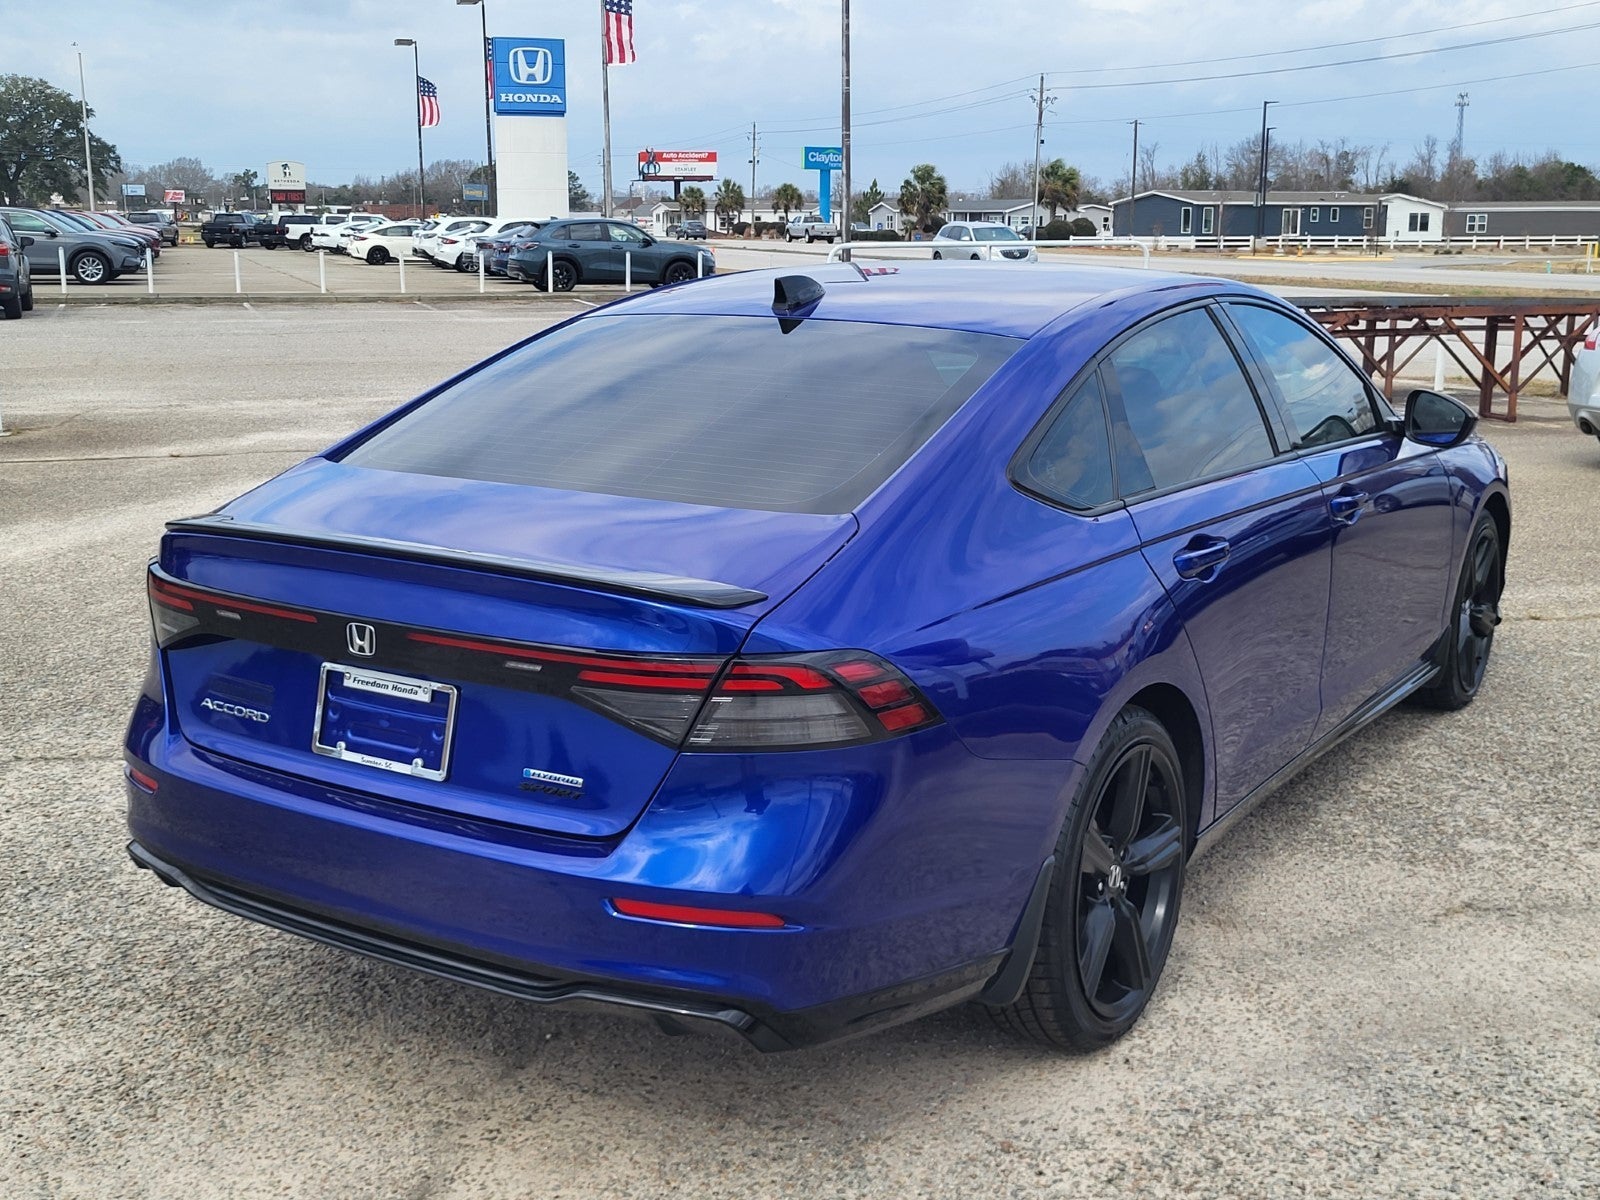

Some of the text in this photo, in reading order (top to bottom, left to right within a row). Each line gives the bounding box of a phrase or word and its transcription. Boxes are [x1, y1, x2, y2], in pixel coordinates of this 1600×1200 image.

[500, 93, 563, 104] HONDA
[352, 677, 418, 696] Freedom Honda
[200, 698, 270, 723] ACCORD
[531, 771, 580, 785] HYBRID
[520, 782, 585, 800] SPORT
